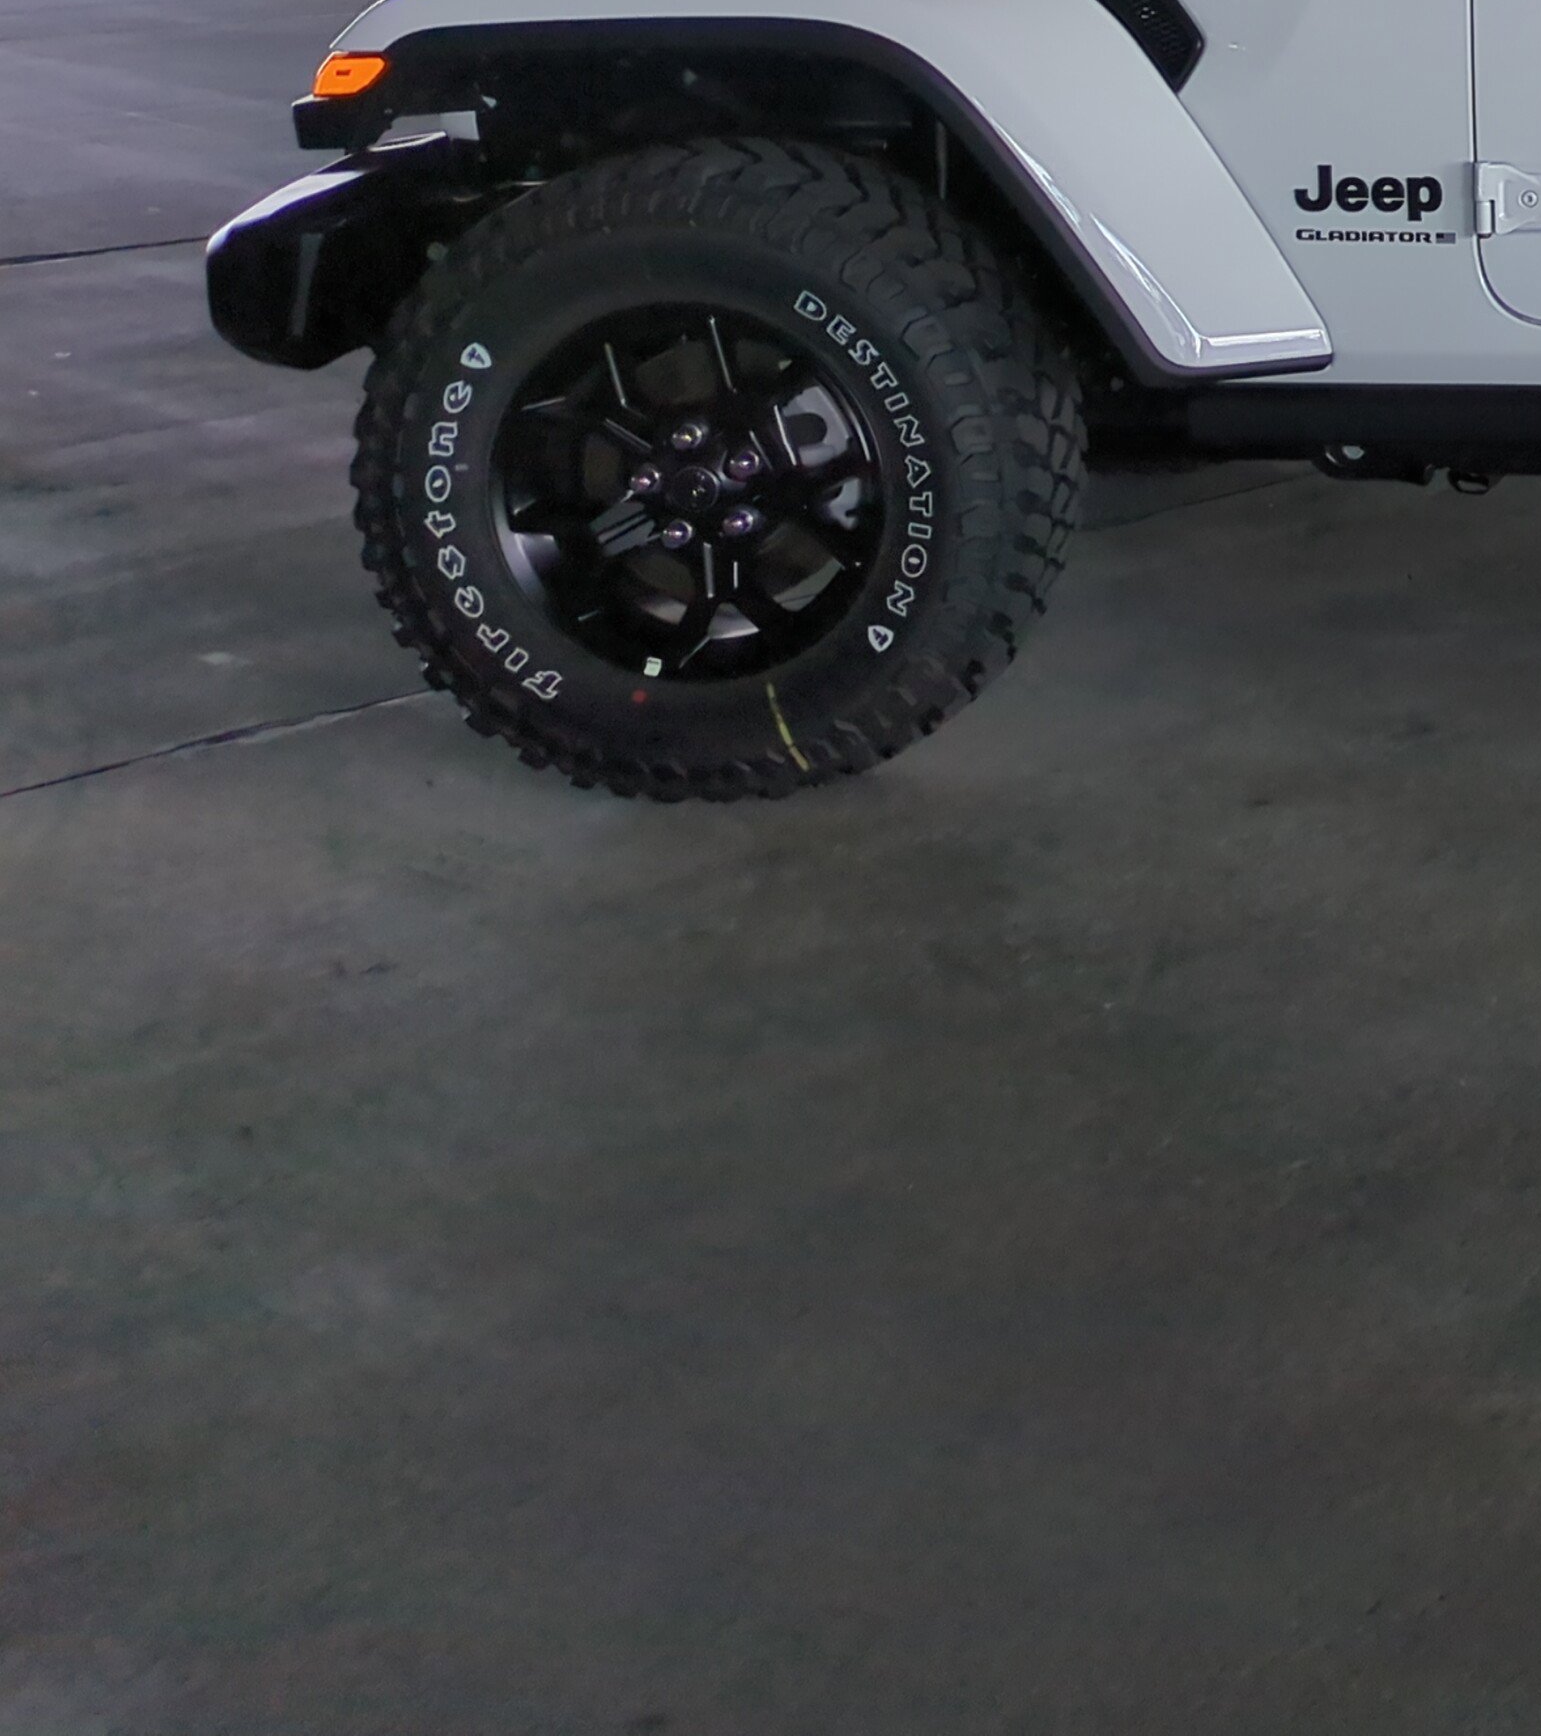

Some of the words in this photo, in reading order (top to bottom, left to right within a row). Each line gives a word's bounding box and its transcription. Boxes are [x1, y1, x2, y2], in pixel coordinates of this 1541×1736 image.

[1294, 165, 1442, 221] Jeep
[1296, 229, 1432, 244] GLADIATOR
[424, 380, 563, 700] Firestone
[794, 290, 932, 616] DESTINATION
